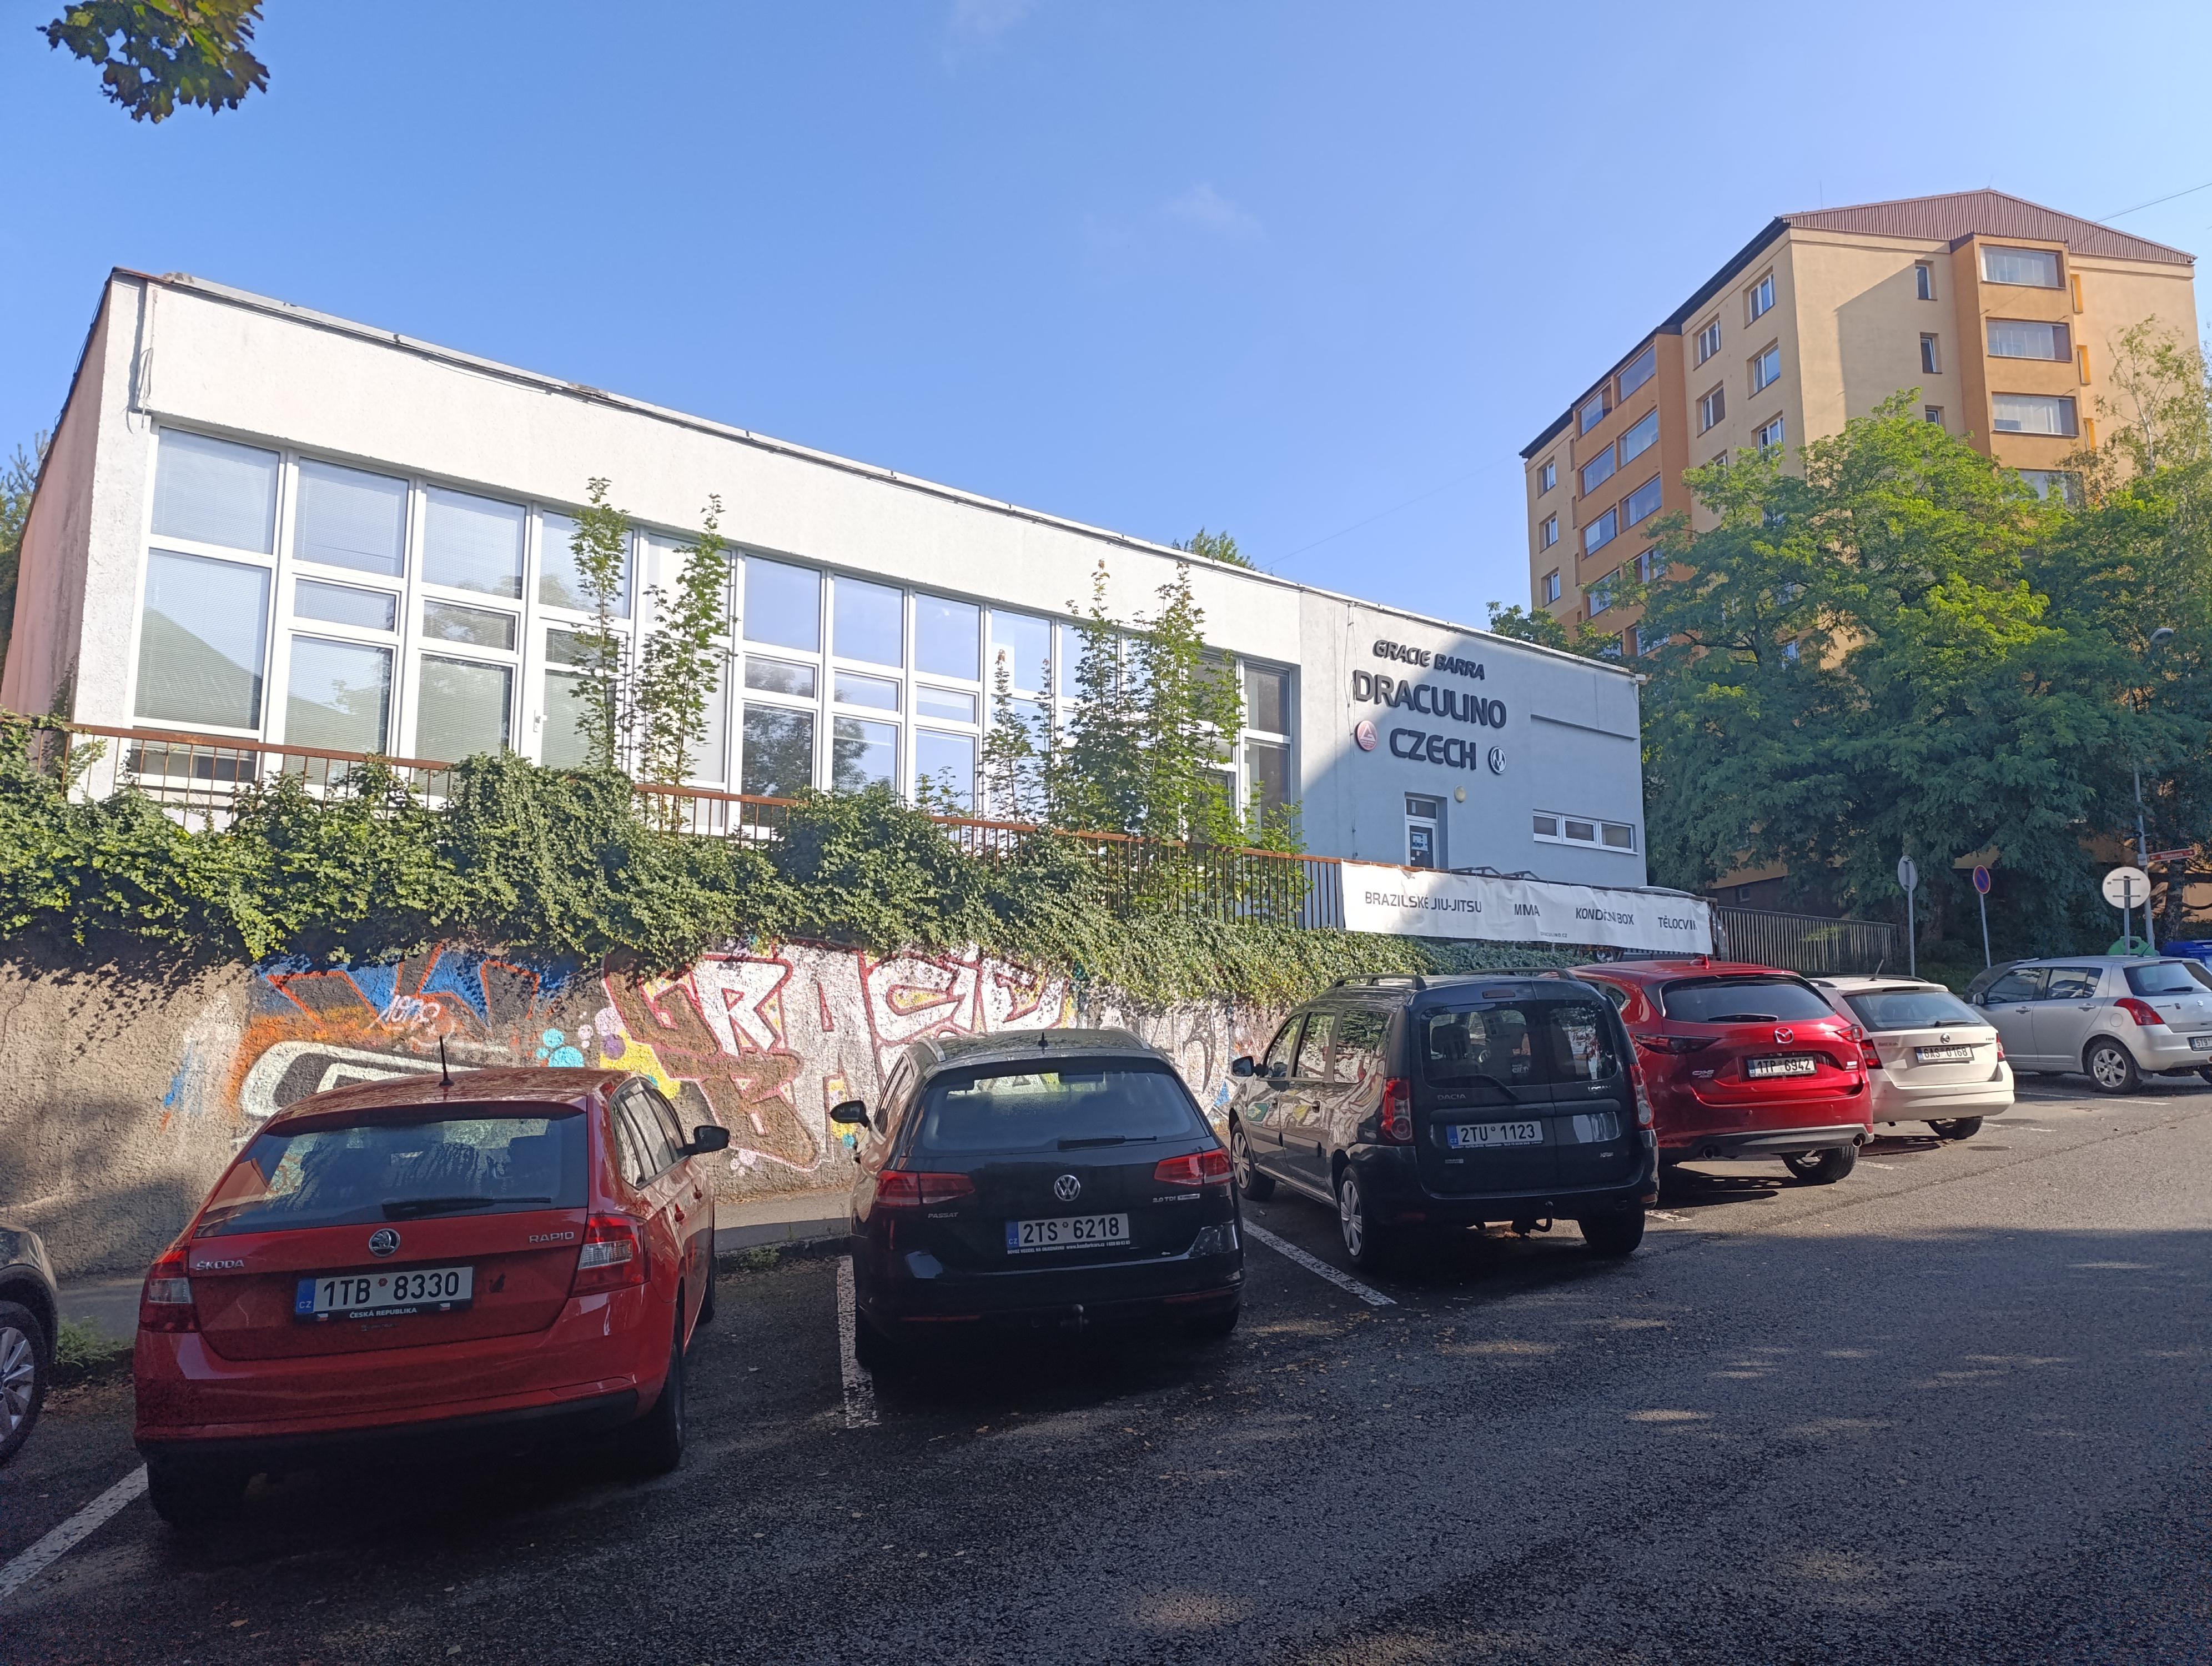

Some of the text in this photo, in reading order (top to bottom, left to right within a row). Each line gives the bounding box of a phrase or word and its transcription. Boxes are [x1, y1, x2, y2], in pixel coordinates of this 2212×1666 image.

[1373, 639, 1485, 680] GRACIE BARRA
[1353, 669, 1507, 729] DRACULINO
[1390, 728, 1477, 770] CZECH
[1365, 891, 1429, 909] BRAZILSKÉ
[1431, 898, 1482, 913] JIU-JITSU
[1515, 904, 1540, 916] MMA
[1616, 912, 1634, 925] BOX
[1924, 1047, 1968, 1058] 6AS 0168
[1758, 1058, 1811, 1073] 1TP 6942
[1461, 1124, 1536, 1143] 2TU 1123
[529, 1231, 574, 1244] RAPID
[1023, 1217, 1120, 1244] 2TS 6218
[196, 1258, 244, 1271] ŠKODA
[323, 1272, 460, 1307] 1TB 8330
[299, 1300, 311, 1311] CZ
[376, 1308, 417, 1316] REPUBLIKA
